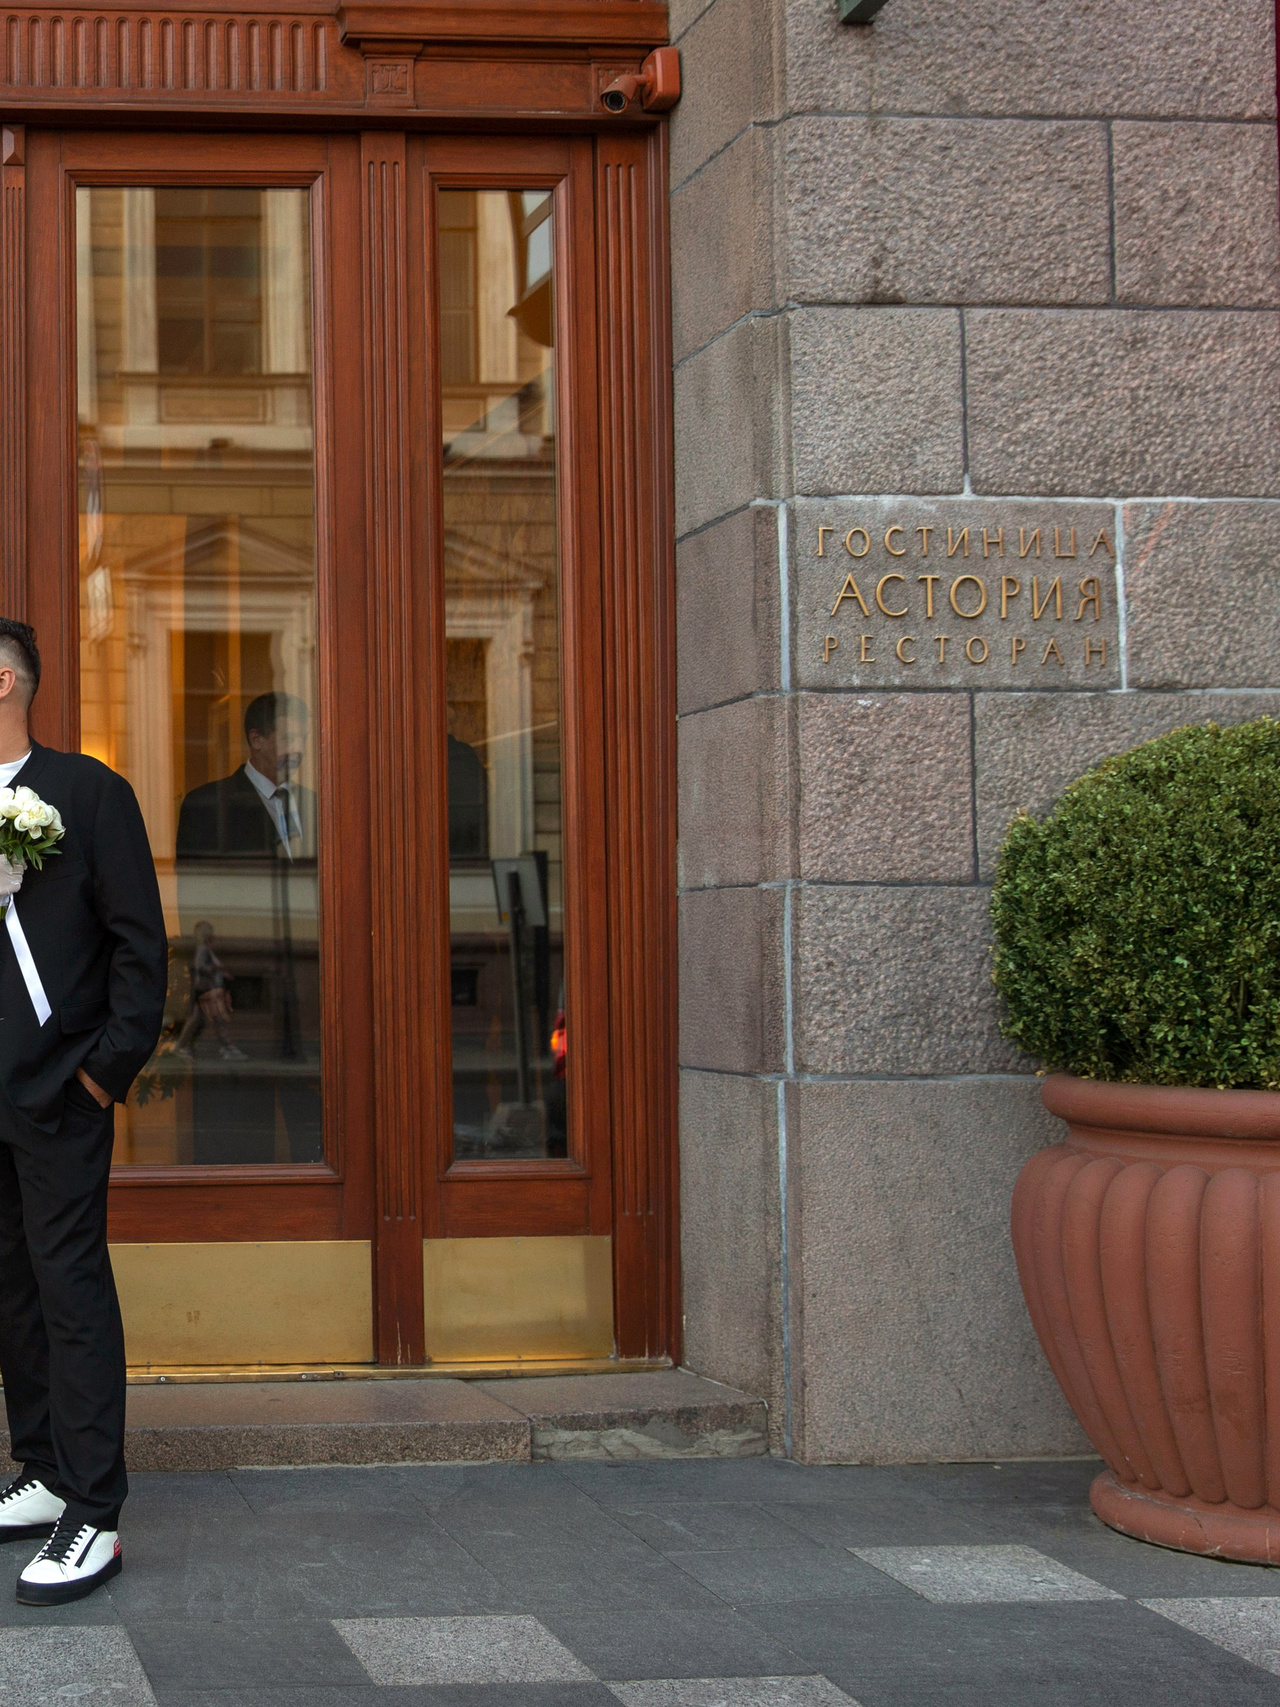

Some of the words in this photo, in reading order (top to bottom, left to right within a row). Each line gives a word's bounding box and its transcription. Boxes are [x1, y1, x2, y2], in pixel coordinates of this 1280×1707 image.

[816, 526, 1116, 558] ГОСТИНИЦА
[831, 573, 1102, 620] АСТОРИЯ
[822, 635, 1106, 666] РЕСТОРАН
